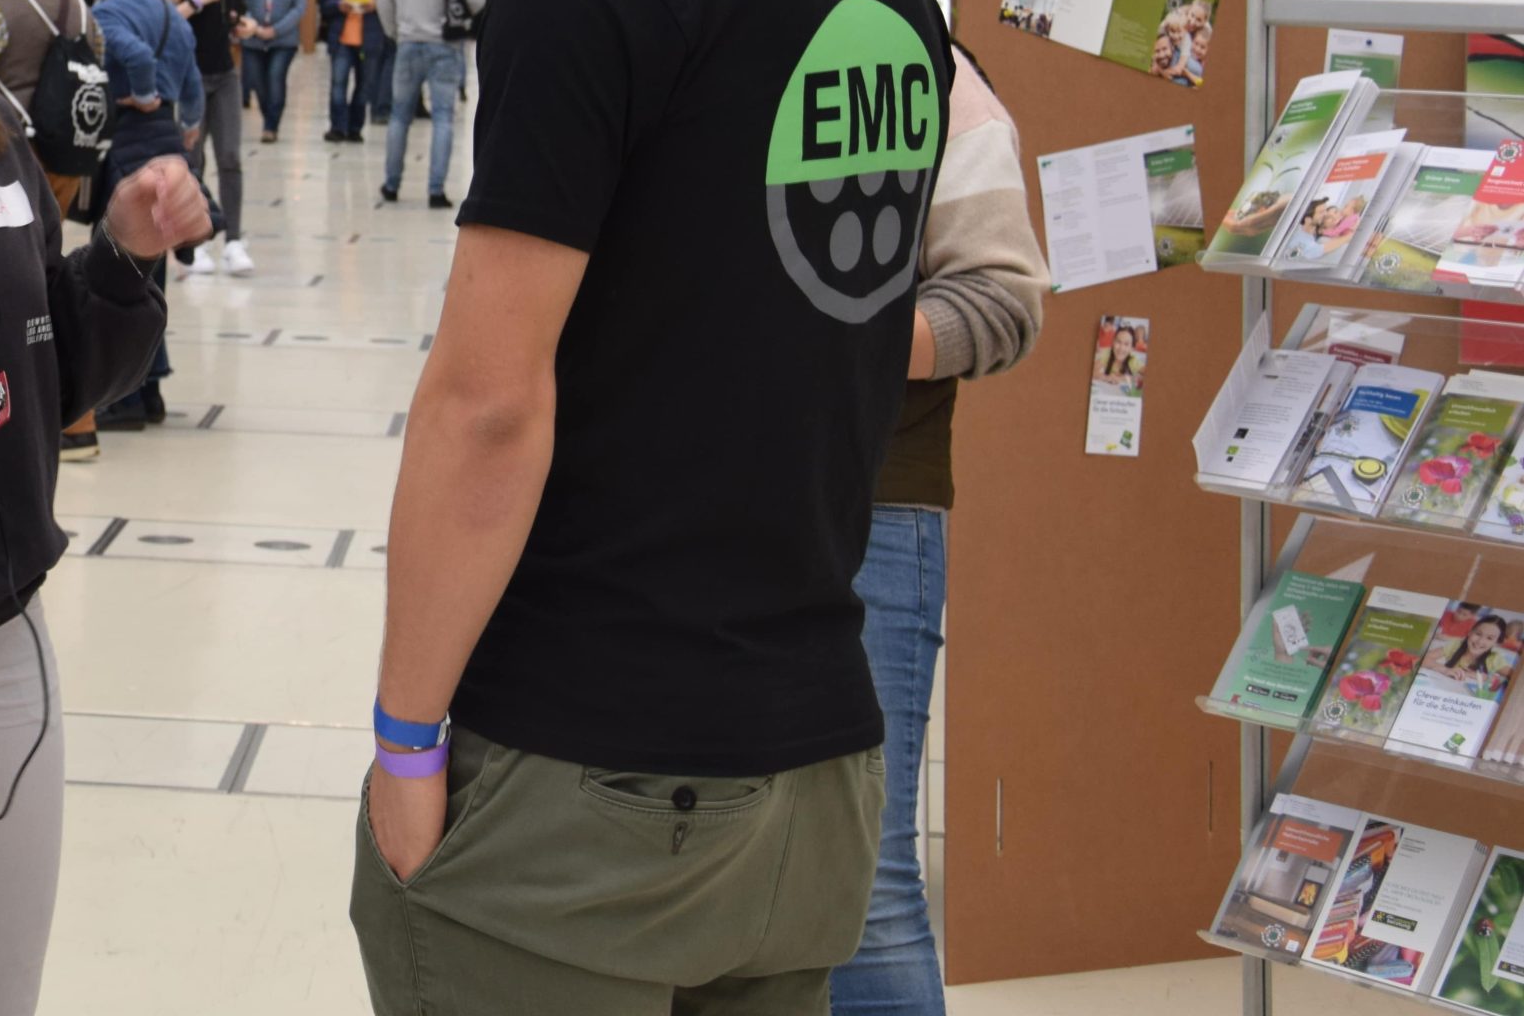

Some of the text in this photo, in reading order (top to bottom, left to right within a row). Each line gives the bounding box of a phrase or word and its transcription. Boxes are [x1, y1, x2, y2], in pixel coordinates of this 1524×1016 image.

[801, 63, 930, 162] EMC
[1416, 689, 1482, 711] Clever einkaufen
[1426, 700, 1439, 709] die
[1439, 703, 1467, 716] Schule
